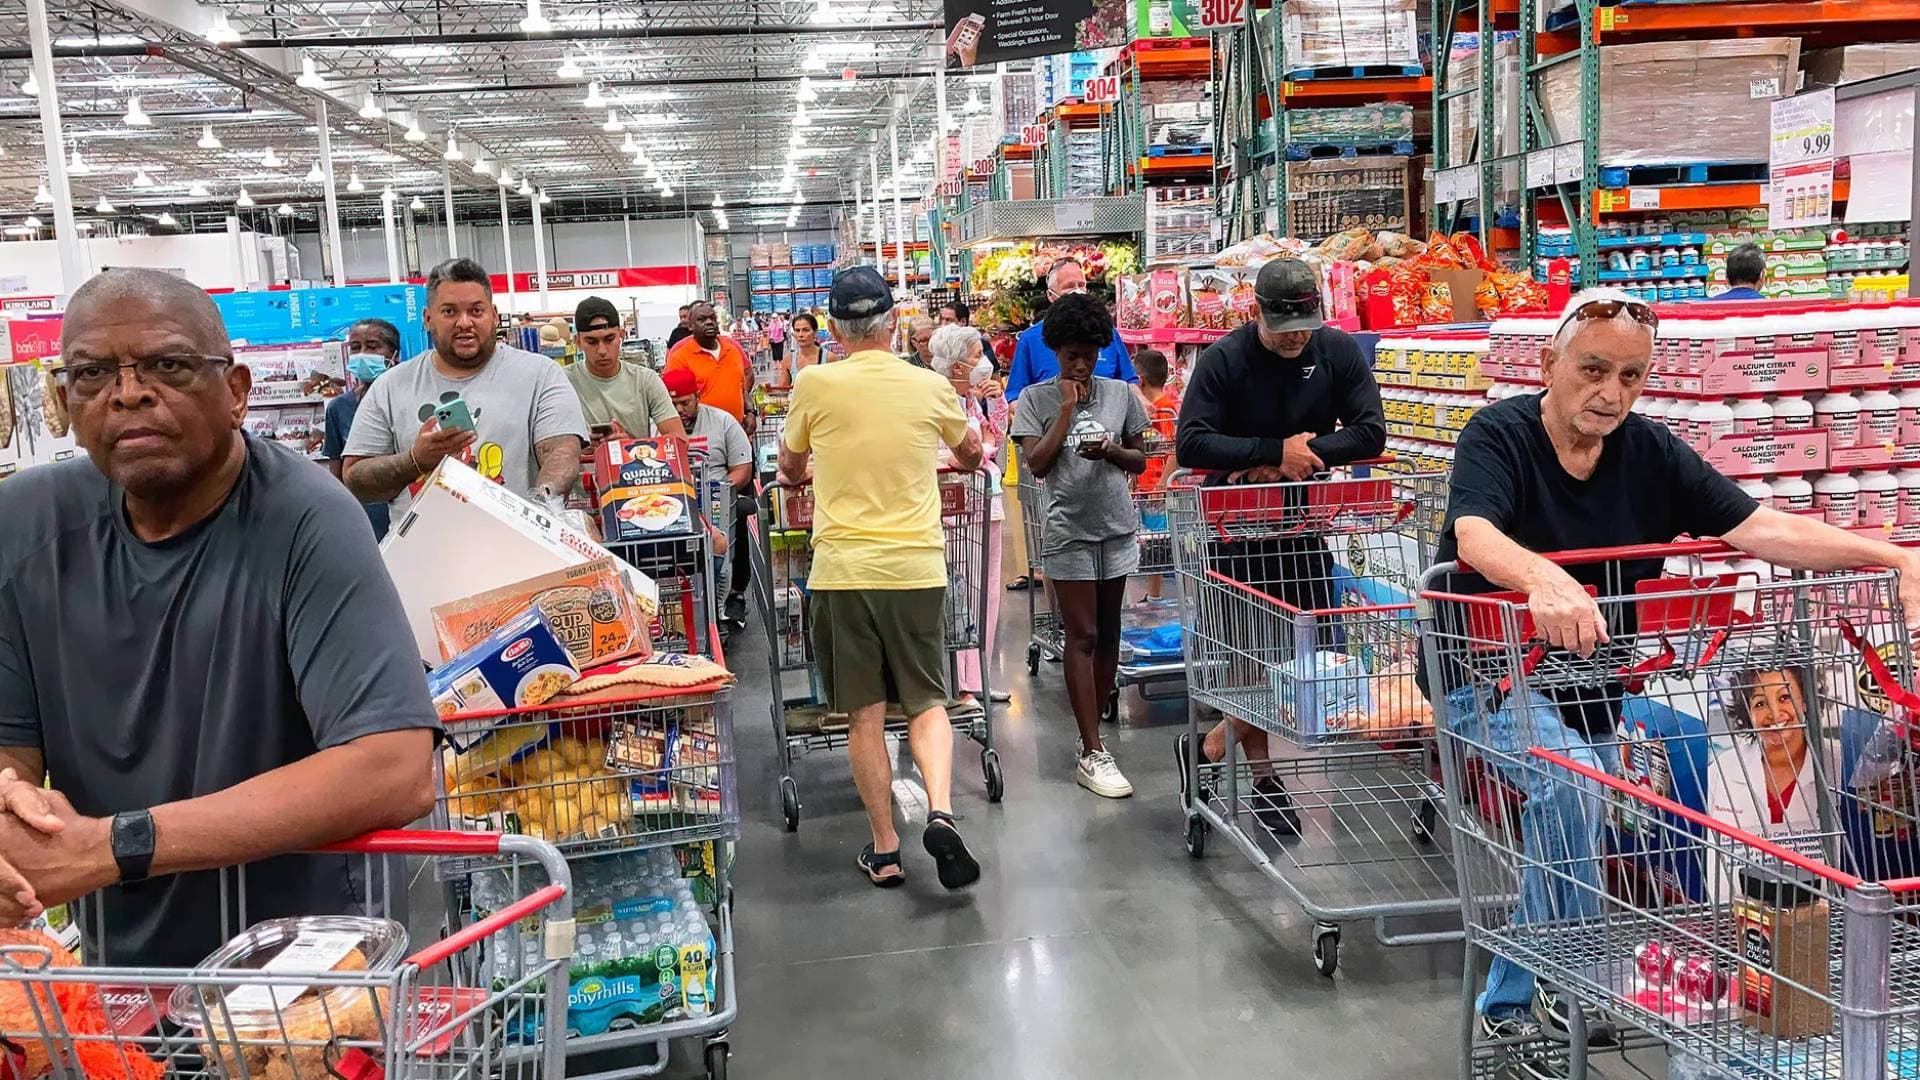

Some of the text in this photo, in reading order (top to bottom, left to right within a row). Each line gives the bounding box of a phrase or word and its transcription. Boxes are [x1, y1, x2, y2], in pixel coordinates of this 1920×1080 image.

[1028, 6, 1044, 14] Floral
[1201, 0, 1244, 26] 302
[997, 17, 1023, 27] Delivered
[997, 32, 1018, 40] Special
[1086, 78, 1117, 102] 304
[1023, 125, 1046, 143] 306
[1803, 134, 1831, 156] 9.99
[974, 159, 995, 174] 308
[943, 182, 960, 195] 310
[921, 198, 936, 209] 312
[581, 273, 610, 286] DELI
[5, 301, 51, 311] KIRKLAND
[289, 292, 302, 329] UNREAL
[405, 287, 418, 324] UNREAL
[1732, 361, 1796, 371] CALCIUM CITRATE
[1742, 368, 1787, 376] MAGNESIUM
[1731, 443, 1796, 453] CALCIUM CITRATE
[1741, 450, 1786, 458] MAGNESIUM
[622, 469, 670, 482] QUAKER
[634, 477, 662, 486] OATS
[484, 480, 551, 529] KETO
[549, 612, 584, 632] CUP
[556, 624, 593, 643] ODLES
[600, 632, 616, 645] 24
[596, 646, 616, 658] 2.5
[684, 950, 703, 964] 40
